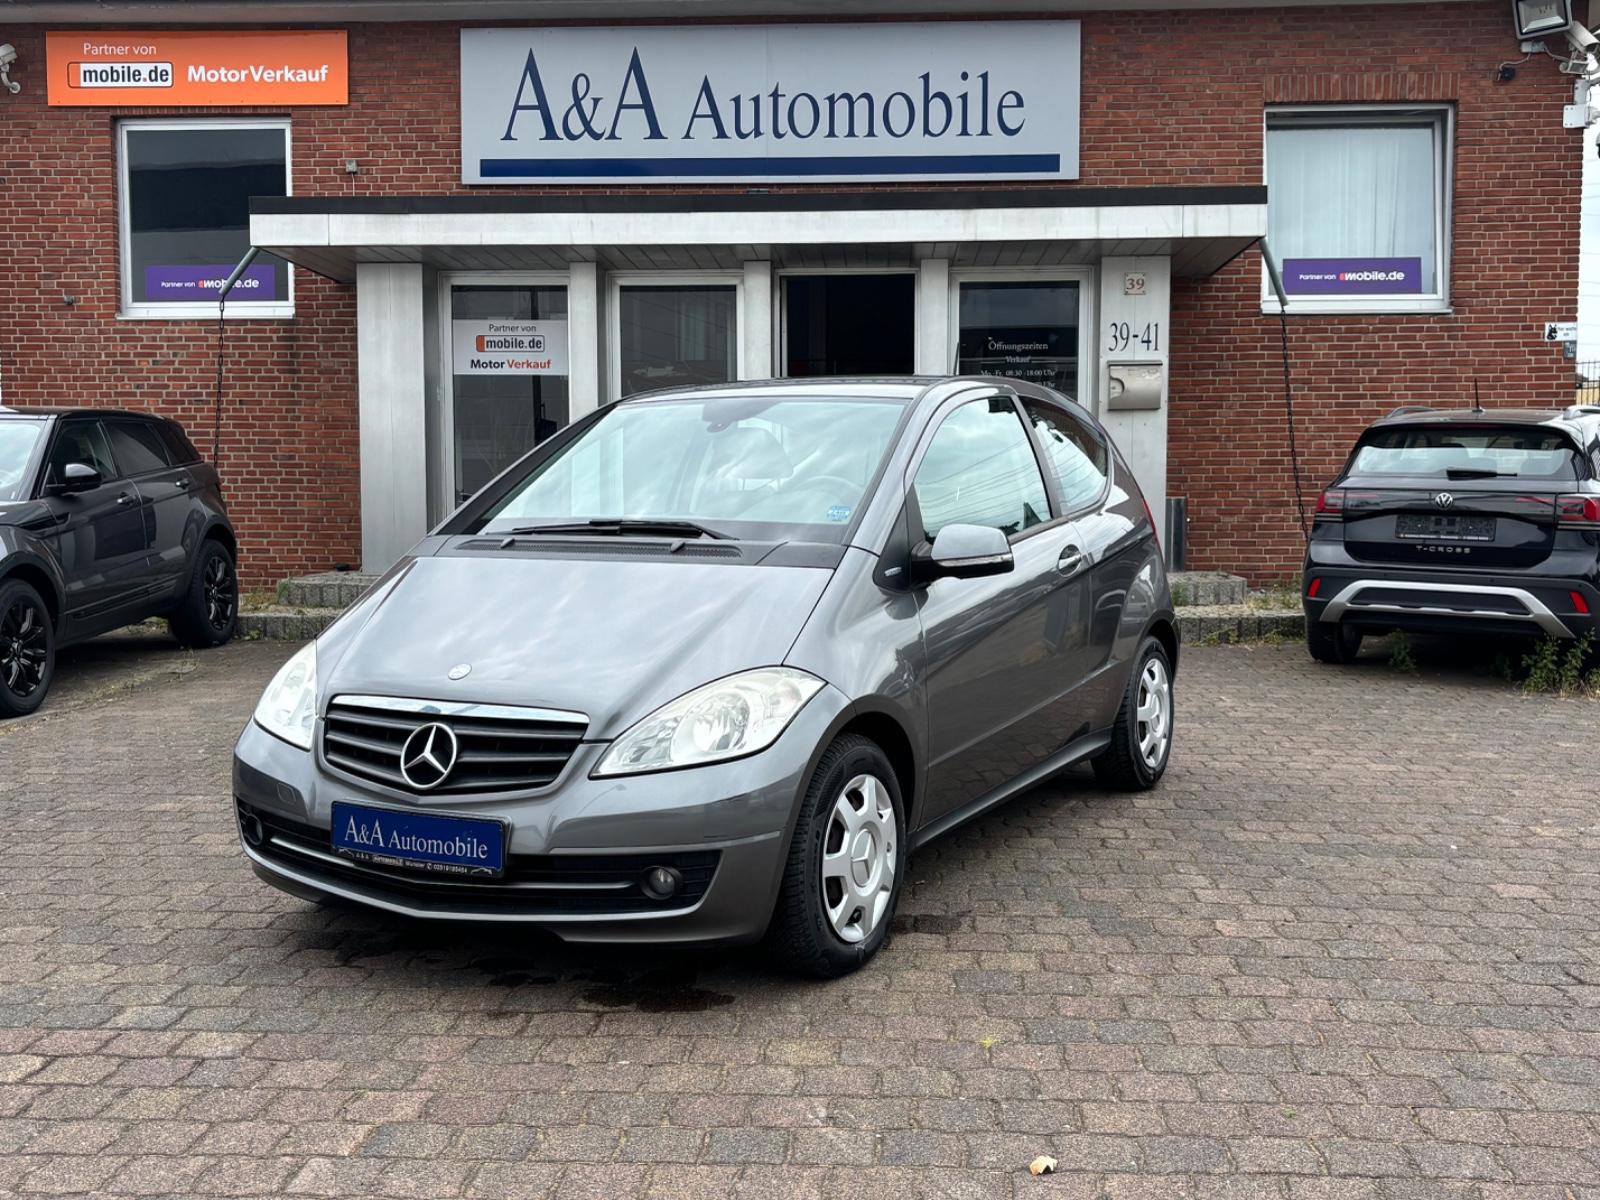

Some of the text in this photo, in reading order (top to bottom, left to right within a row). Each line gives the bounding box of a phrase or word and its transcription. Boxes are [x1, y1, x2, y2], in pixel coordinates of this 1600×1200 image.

[83, 43, 157, 55] Partner von
[82, 65, 170, 83] mobile.de
[500, 46, 1026, 142] A&A Automobile
[1344, 270, 1405, 281] mobile.de
[1126, 278, 1145, 290] 39
[488, 323, 537, 333] Partner von
[485, 336, 542, 349] mobile.de
[1108, 322, 1159, 352] 39-41
[988, 337, 1049, 352] Öffnungszeiten
[1415, 545, 1471, 554] T-CROSS
[344, 815, 488, 859] A&A Automobile
